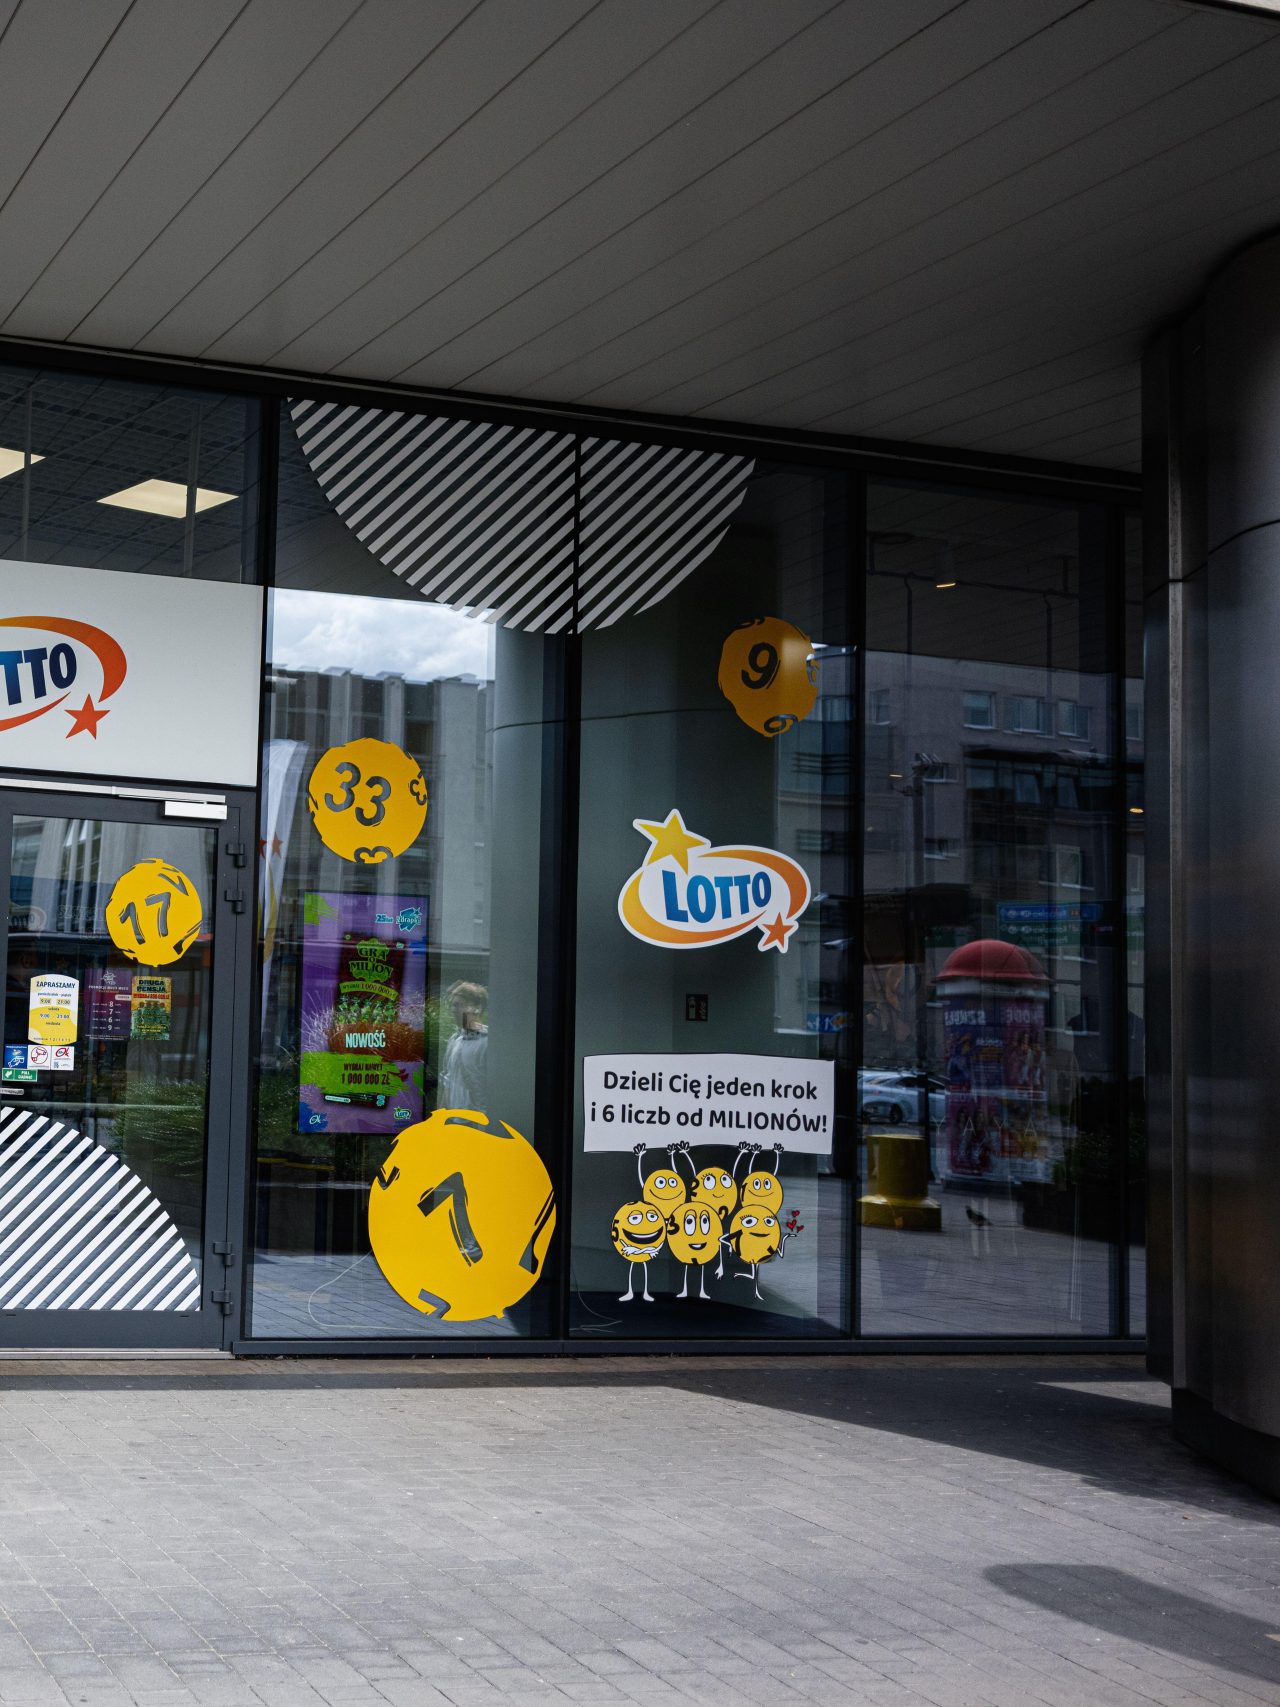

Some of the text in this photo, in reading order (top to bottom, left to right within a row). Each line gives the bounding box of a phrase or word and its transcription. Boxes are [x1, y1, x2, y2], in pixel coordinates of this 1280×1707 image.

[742, 642, 779, 689] 9
[324, 762, 391, 827] 33
[661, 869, 772, 924] LOTTO
[120, 892, 172, 945] 17
[359, 947, 387, 958] GRA
[36, 981, 76, 989] ZAPRASZAMY
[345, 1030, 386, 1048] NOWOŚĆ
[348, 1073, 362, 1085] 000
[364, 1073, 379, 1085] 000
[603, 1070, 817, 1100] Dzieli Cię jeden krok
[591, 1101, 827, 1133] i 6 liczb od MILIONÓW!
